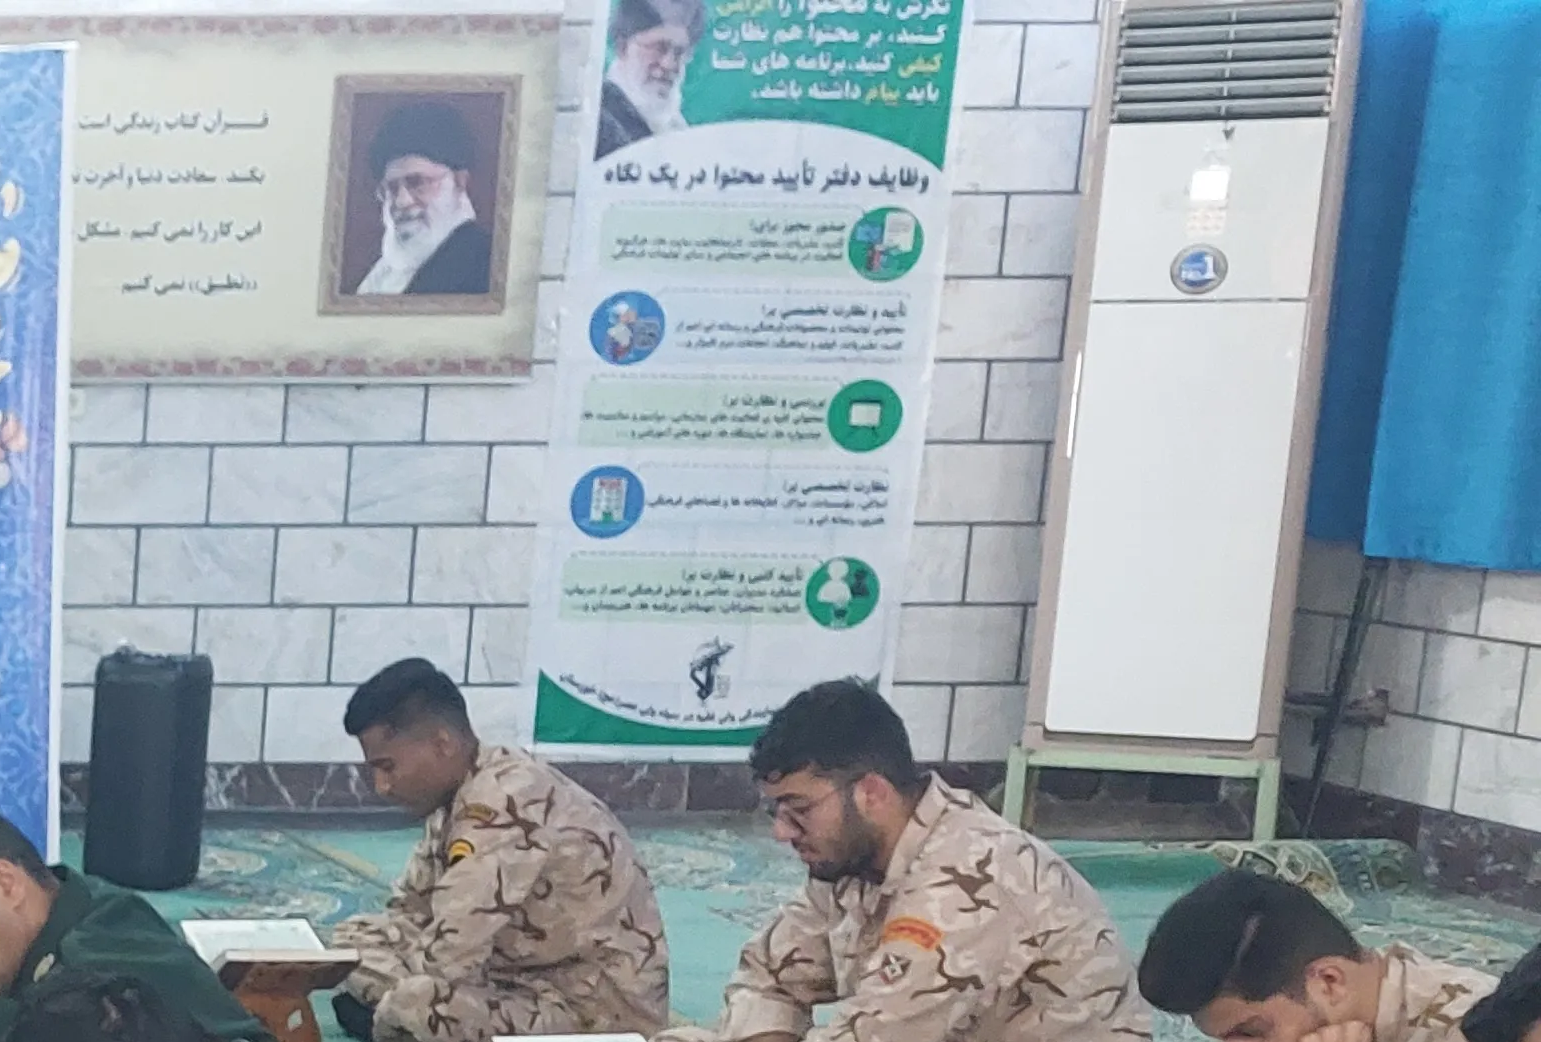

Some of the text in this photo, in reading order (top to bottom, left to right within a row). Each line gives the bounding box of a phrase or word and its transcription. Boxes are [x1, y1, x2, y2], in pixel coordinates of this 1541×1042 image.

[712, 50, 748, 70] شما
[752, 50, 790, 75] های
[808, 80, 861, 101] داشته
[77, 111, 112, 131] است
[164, 110, 202, 131] کتاب
[126, 173, 134, 190] و
[135, 165, 164, 187] دنیا
[603, 156, 930, 194] وظایف دفتر تأیید محتوا در یک نگاه
[76, 220, 122, 243] مشکل
[163, 223, 196, 243] نمی
[197, 220, 209, 244] را
[209, 220, 234, 244] کار
[120, 273, 153, 295] کنیم
[154, 275, 187, 296] نمی
